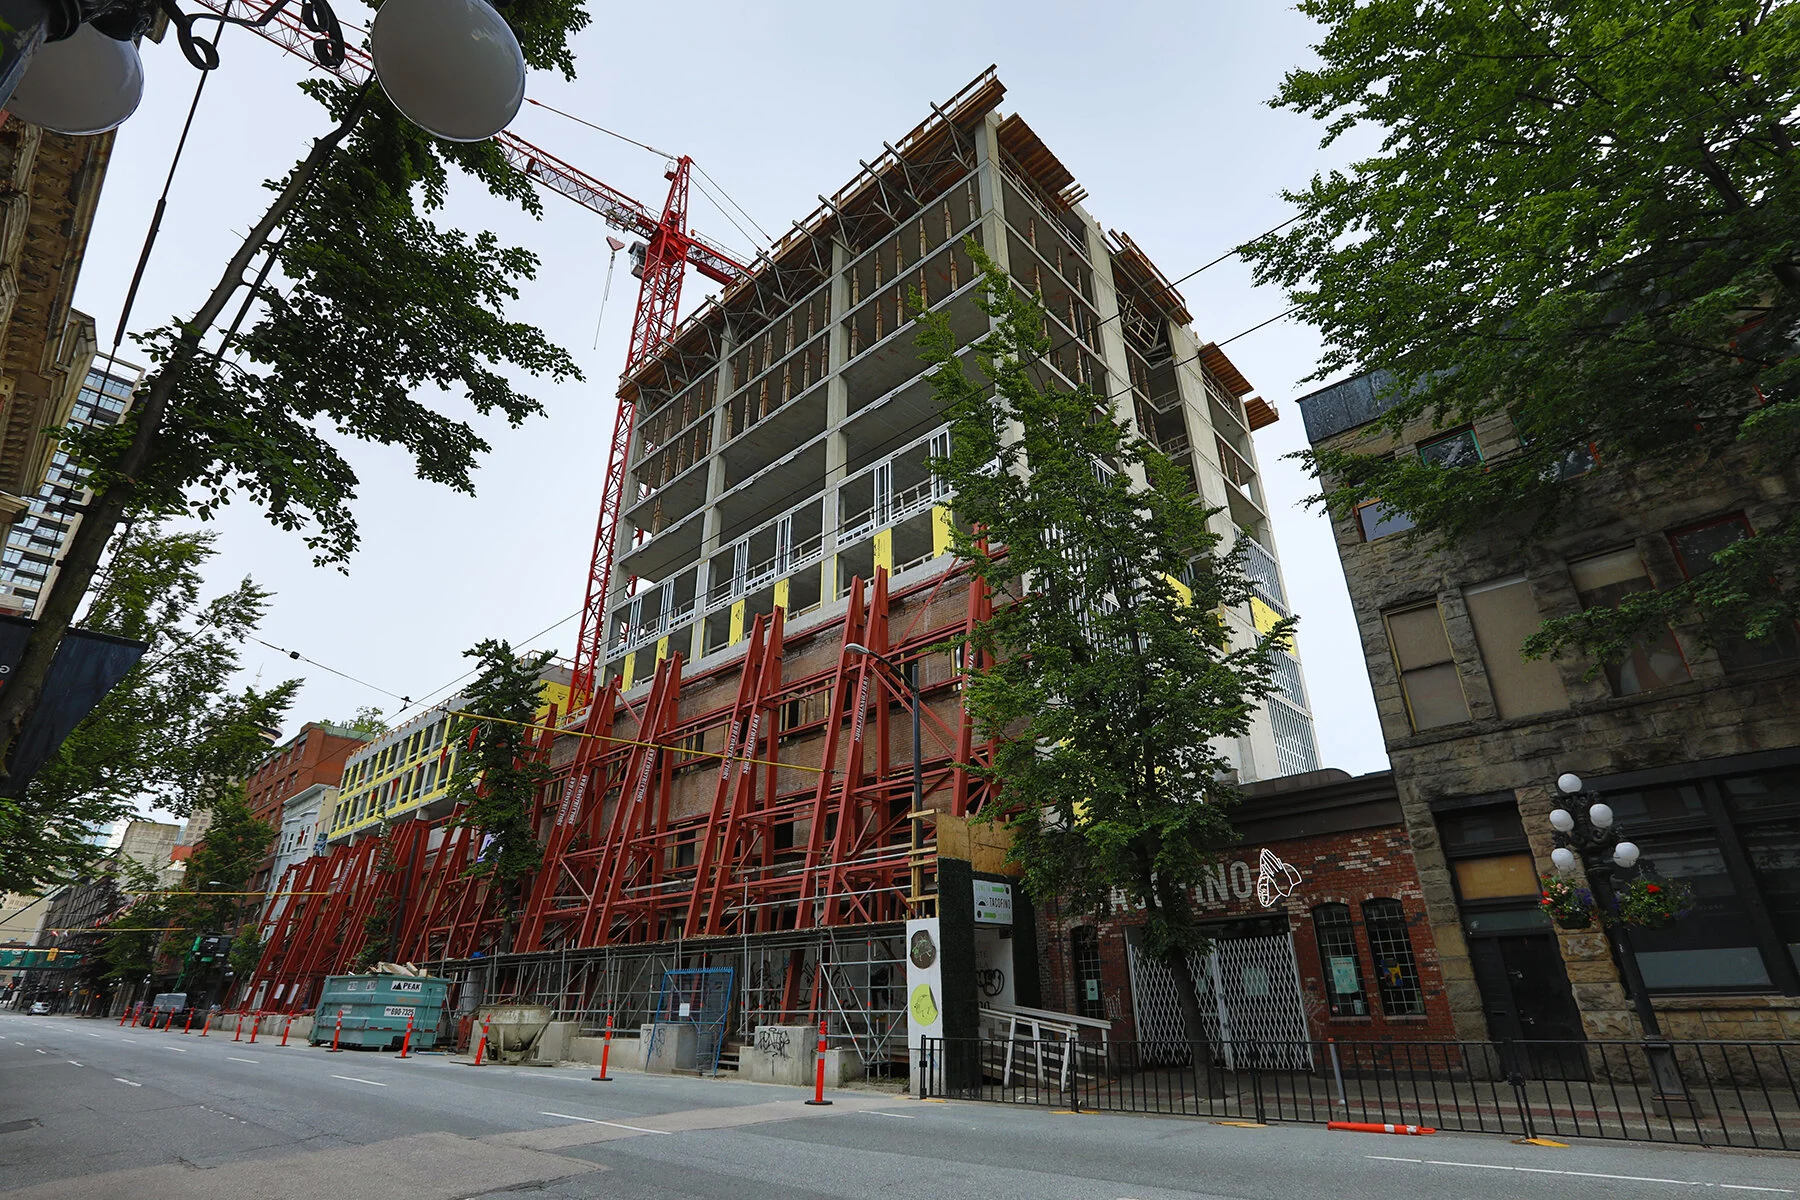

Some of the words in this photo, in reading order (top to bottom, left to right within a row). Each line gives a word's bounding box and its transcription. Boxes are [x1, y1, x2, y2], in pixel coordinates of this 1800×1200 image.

[722, 734, 737, 780] CONSTRCTORS
[742, 728, 757, 775] CONSTRUCORS
[989, 896, 1011, 909] TACOFINO
[403, 982, 421, 990] PEAK
